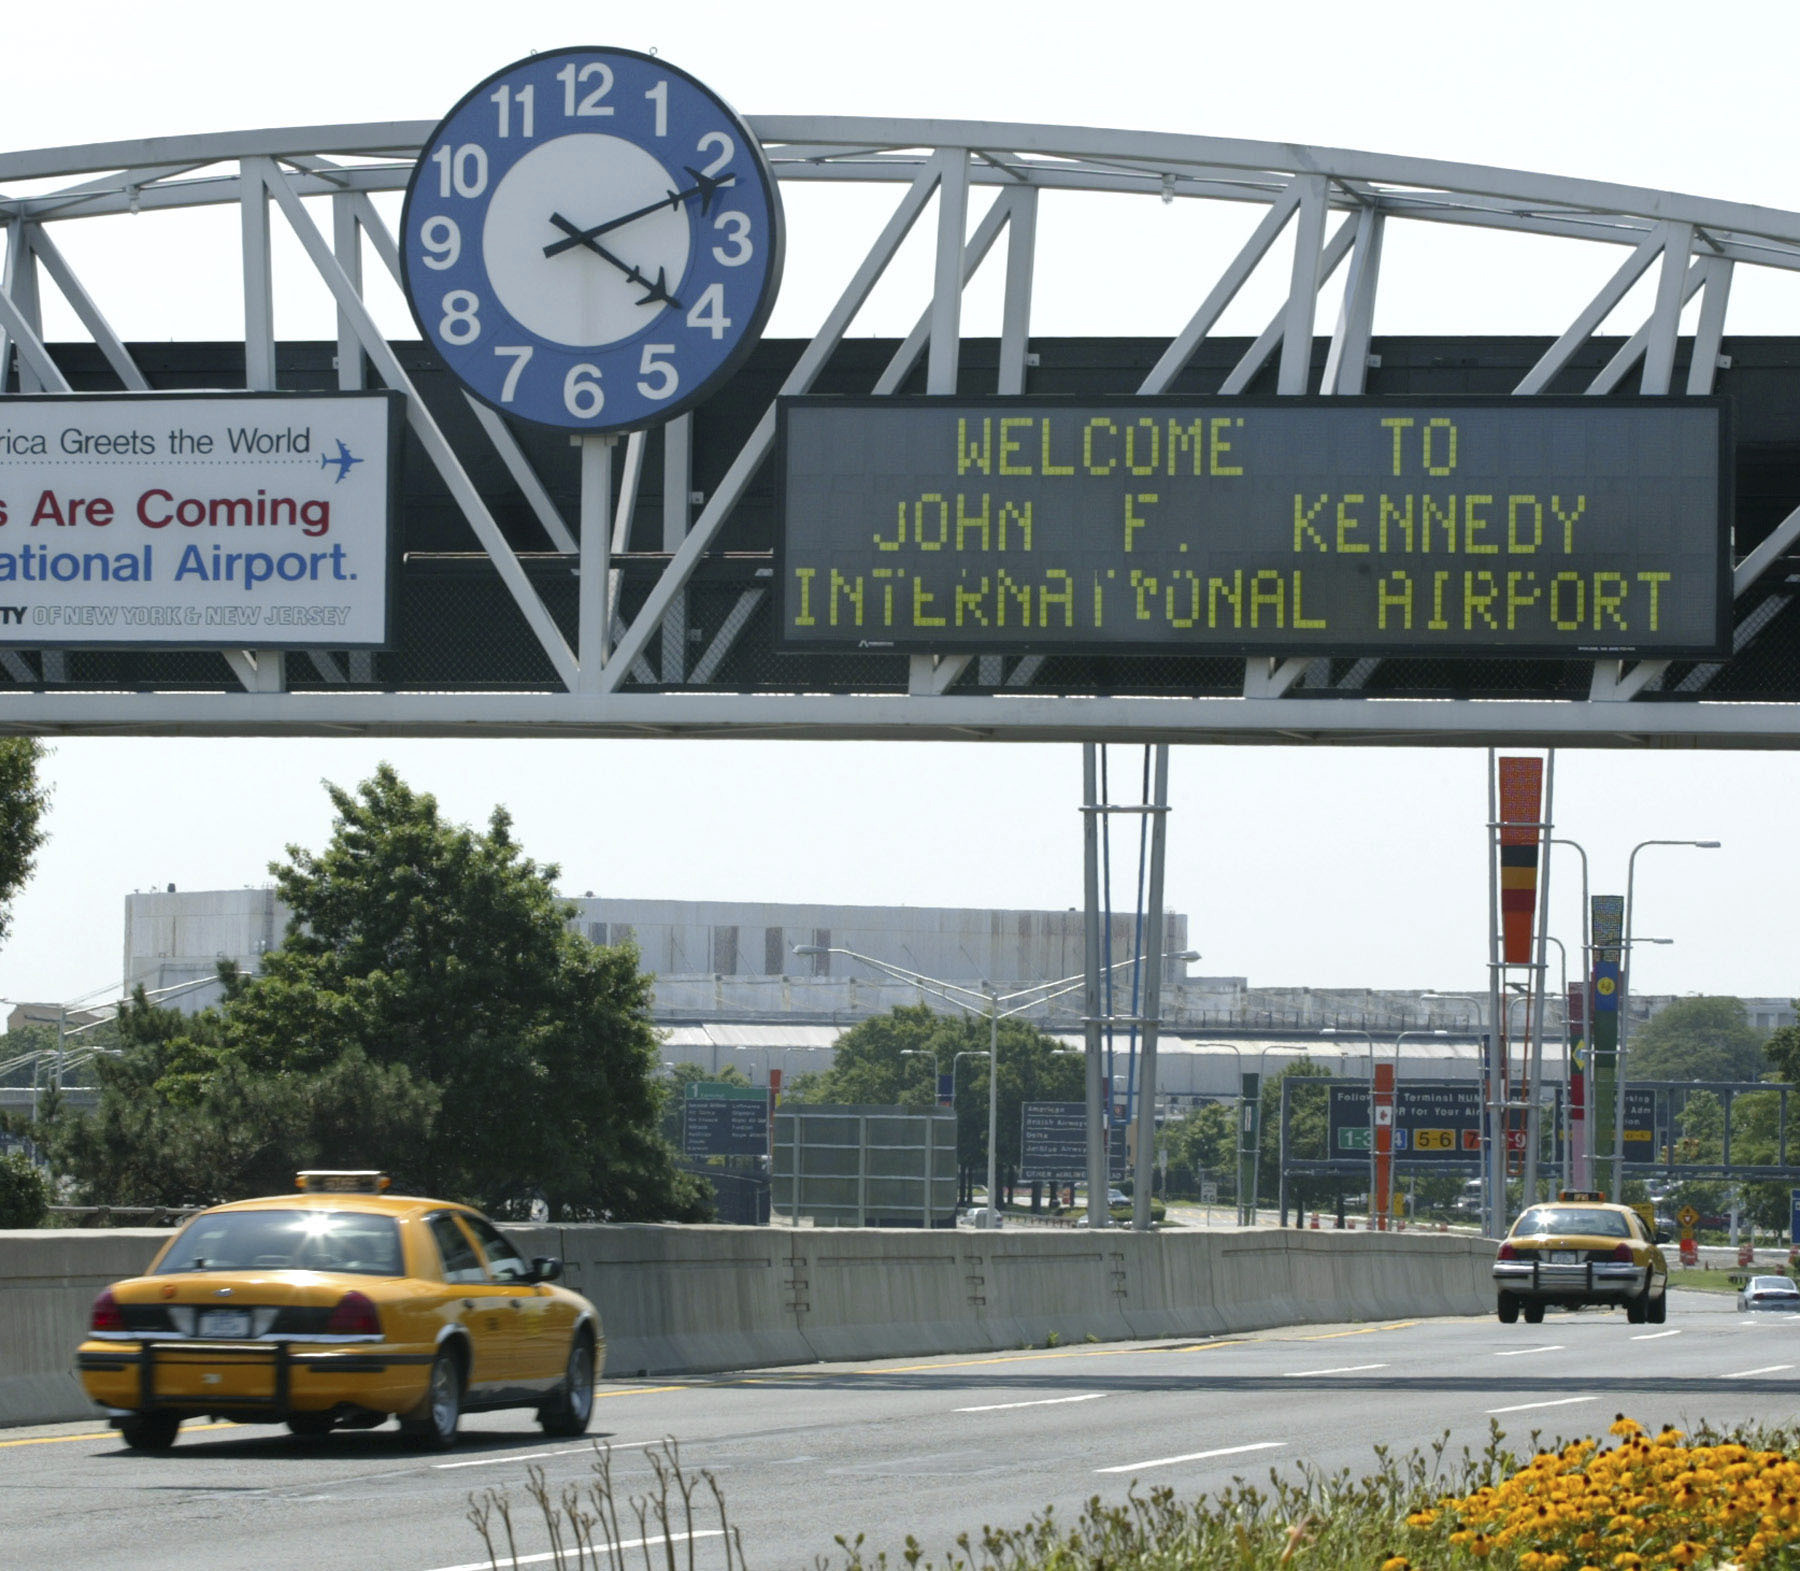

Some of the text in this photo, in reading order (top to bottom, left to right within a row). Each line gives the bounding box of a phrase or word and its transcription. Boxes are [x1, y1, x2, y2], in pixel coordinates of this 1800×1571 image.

[490, 83, 535, 138] 11
[555, 61, 615, 117] 12
[644, 79, 669, 137] 1
[431, 142, 489, 199] 10
[695, 130, 736, 188] 2
[420, 214, 462, 271] 9
[711, 209, 754, 267] 3
[438, 289, 482, 346] 8
[685, 282, 732, 340] 4
[493, 345, 534, 403] 7
[563, 362, 605, 419] 6
[636, 343, 680, 401] 5
[60, 428, 155, 455] Greets
[168, 428, 214, 455] the
[227, 427, 311, 454] World
[958, 418, 1457, 475] WELCOME TO
[30, 489, 115, 527] Are
[136, 488, 331, 537] Coming
[873, 494, 1032, 551] JOHN
[1294, 494, 1586, 553] KENNEDY
[0, 543, 358, 591] ational Airport.
[33, 606, 61, 626] OF
[64, 606, 118, 626] NEW
[121, 606, 182, 626] YORK
[184, 606, 201, 626] &
[205, 606, 261, 626] NEW
[264, 606, 352, 626] JERSEY
[1378, 570, 1671, 631] AIRPORT
[1404, 1093, 1453, 1102] Terminal
[1411, 1107, 1428, 1116] for
[1434, 1107, 1459, 1116] Your
[1061, 1146, 1087, 1154] Airway
[1418, 1131, 1452, 1148] 5-6
[1466, 1132, 1480, 1148] 7
